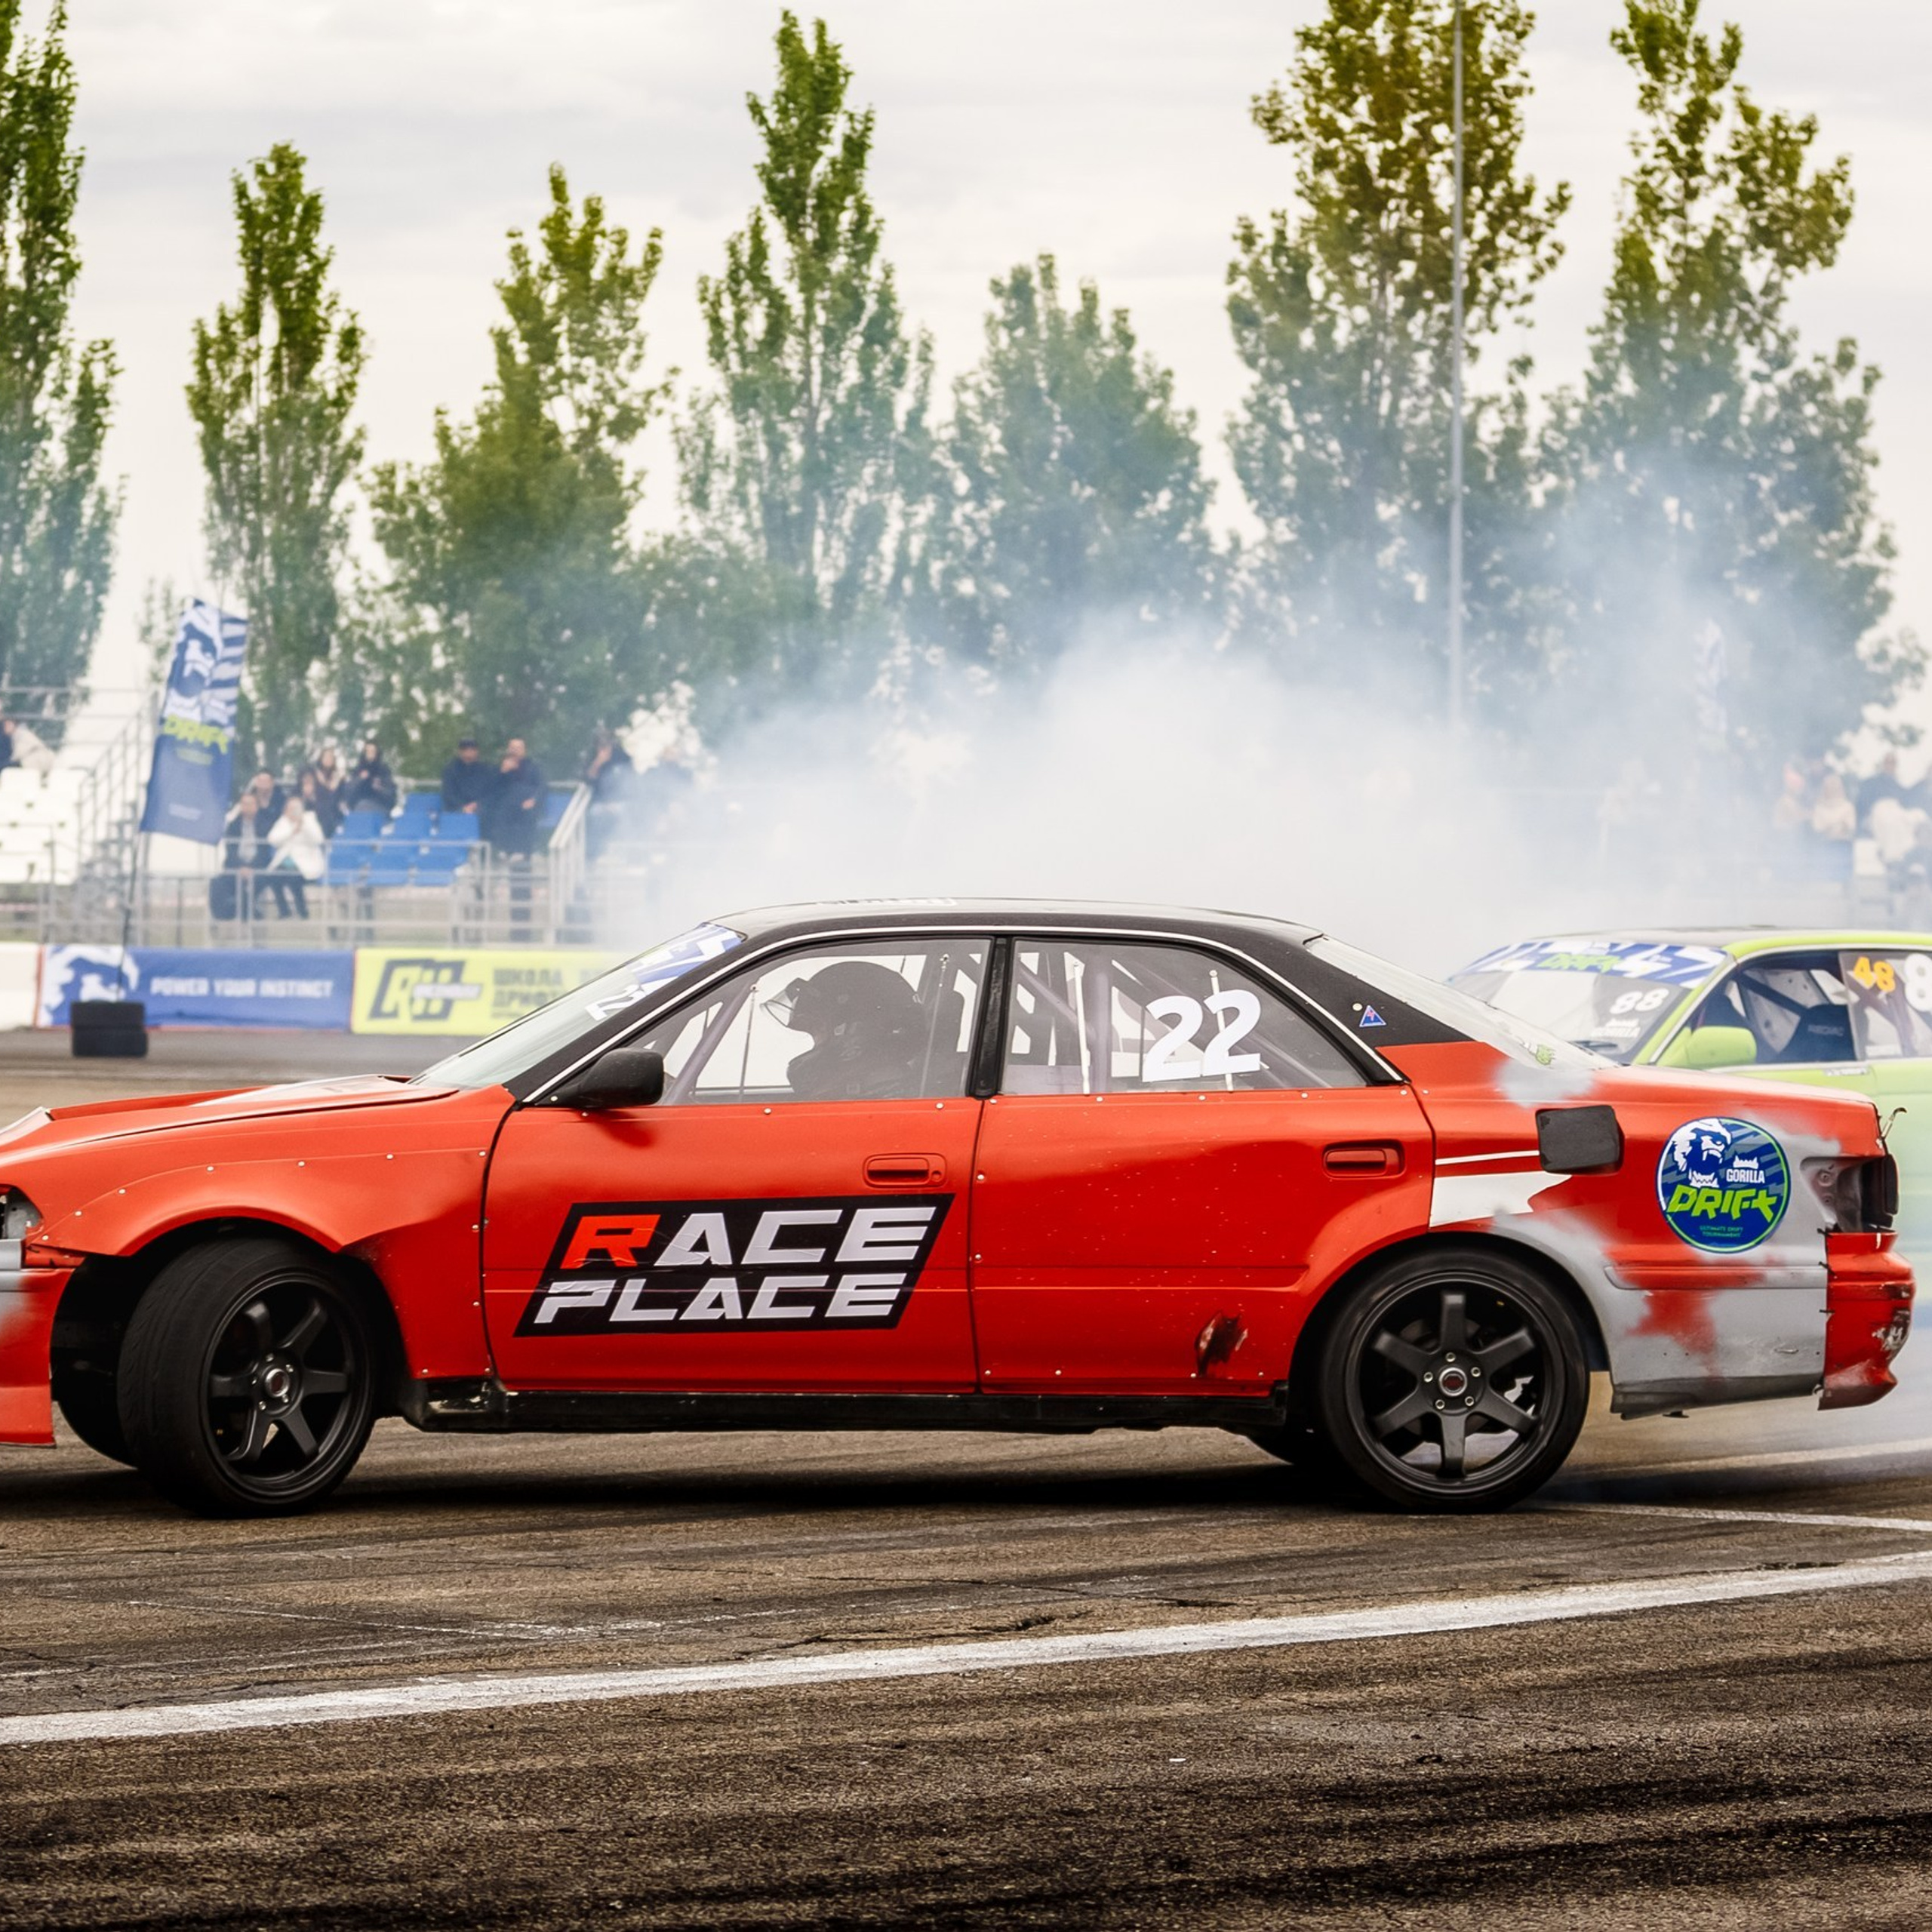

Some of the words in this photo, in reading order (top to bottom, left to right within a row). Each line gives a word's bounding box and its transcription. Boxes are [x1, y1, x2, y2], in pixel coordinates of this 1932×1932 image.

[151, 977, 209, 996] POWER
[214, 978, 257, 997] YOUR
[260, 979, 333, 998] INSTINCT
[1853, 956, 1896, 992] 48
[1609, 987, 1669, 1014] 88
[1142, 989, 1261, 1082] 22
[1725, 1168, 1766, 1183] GORILLA
[1666, 1184, 1777, 1223] DRIFT
[560, 1207, 937, 1269] RACE
[534, 1272, 907, 1324] PLACE
